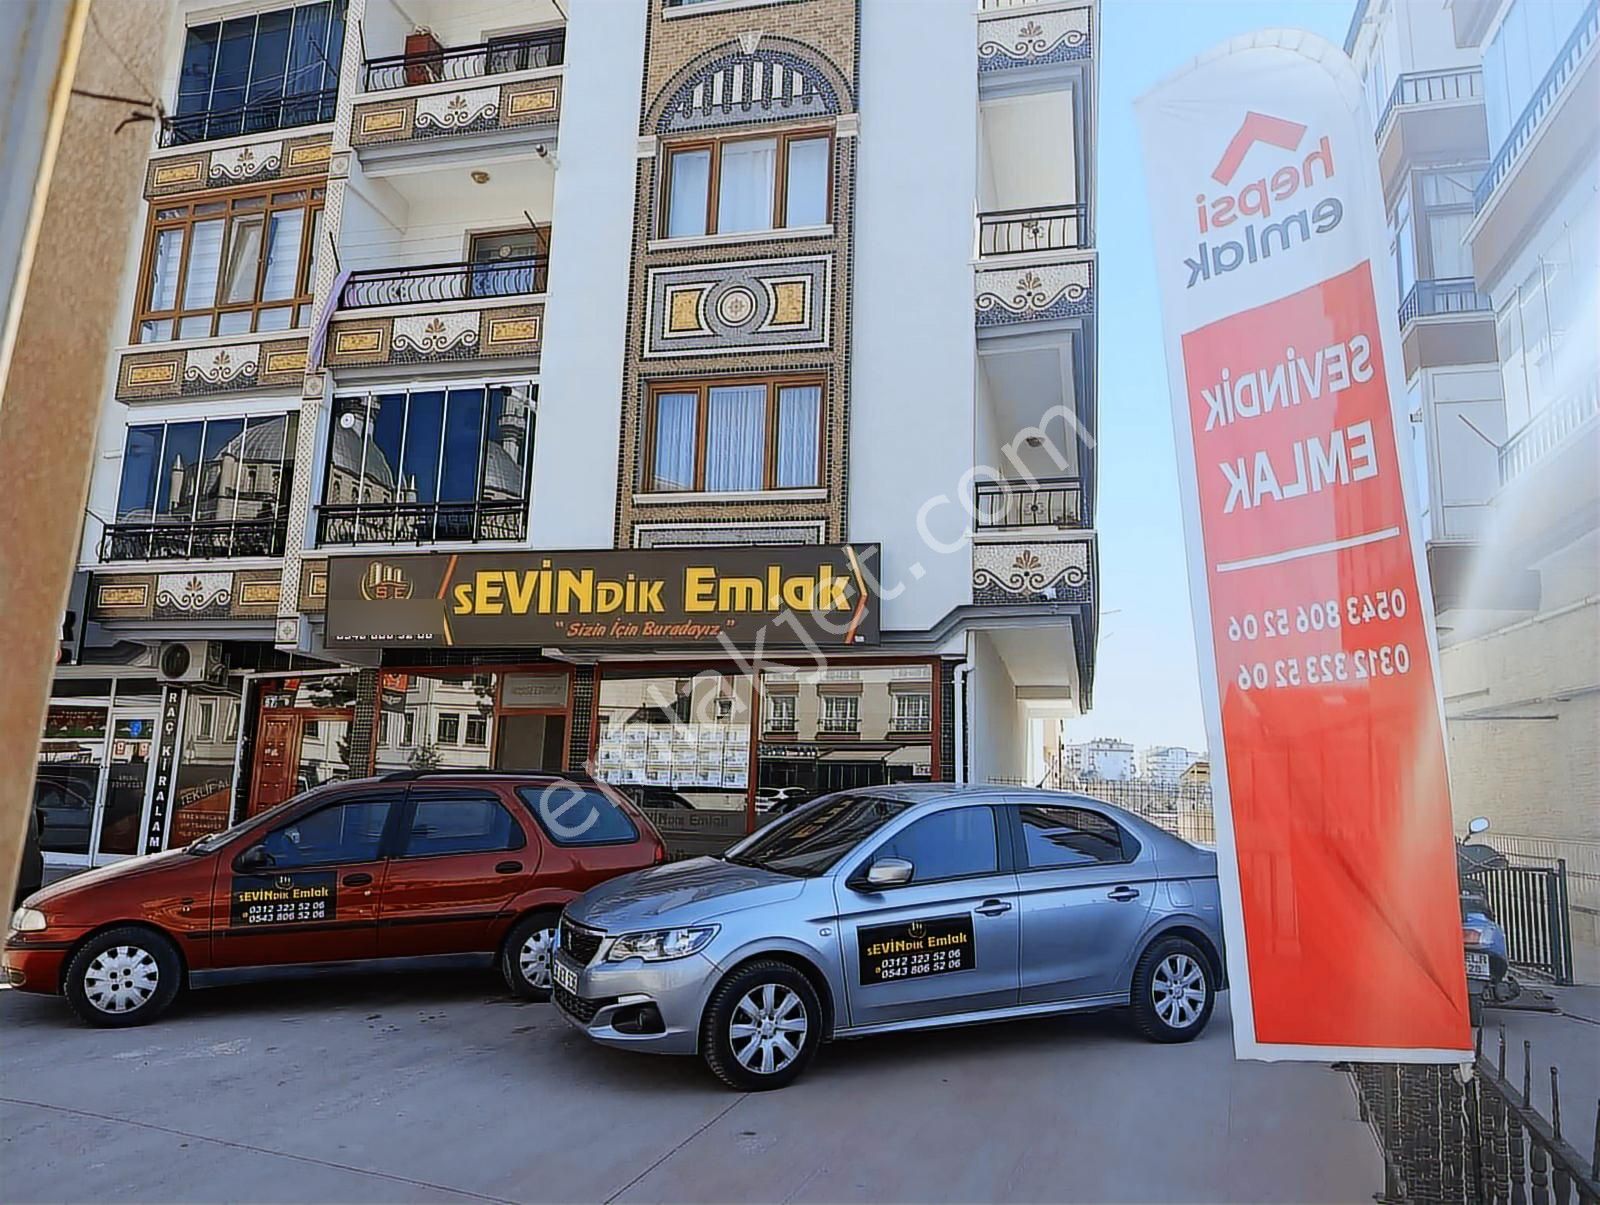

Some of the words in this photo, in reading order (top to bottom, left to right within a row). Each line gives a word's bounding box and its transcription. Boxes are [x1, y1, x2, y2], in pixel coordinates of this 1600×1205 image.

[685, 563, 852, 613] Emlak
[610, 617, 639, 639] İçin
[165, 692, 177, 735] RAÇ
[149, 746, 172, 848] KİRALAM
[881, 956, 908, 969] 0312
[910, 953, 930, 965] 323
[933, 950, 945, 960] 52
[948, 949, 960, 959] 06
[881, 967, 908, 979] 0543
